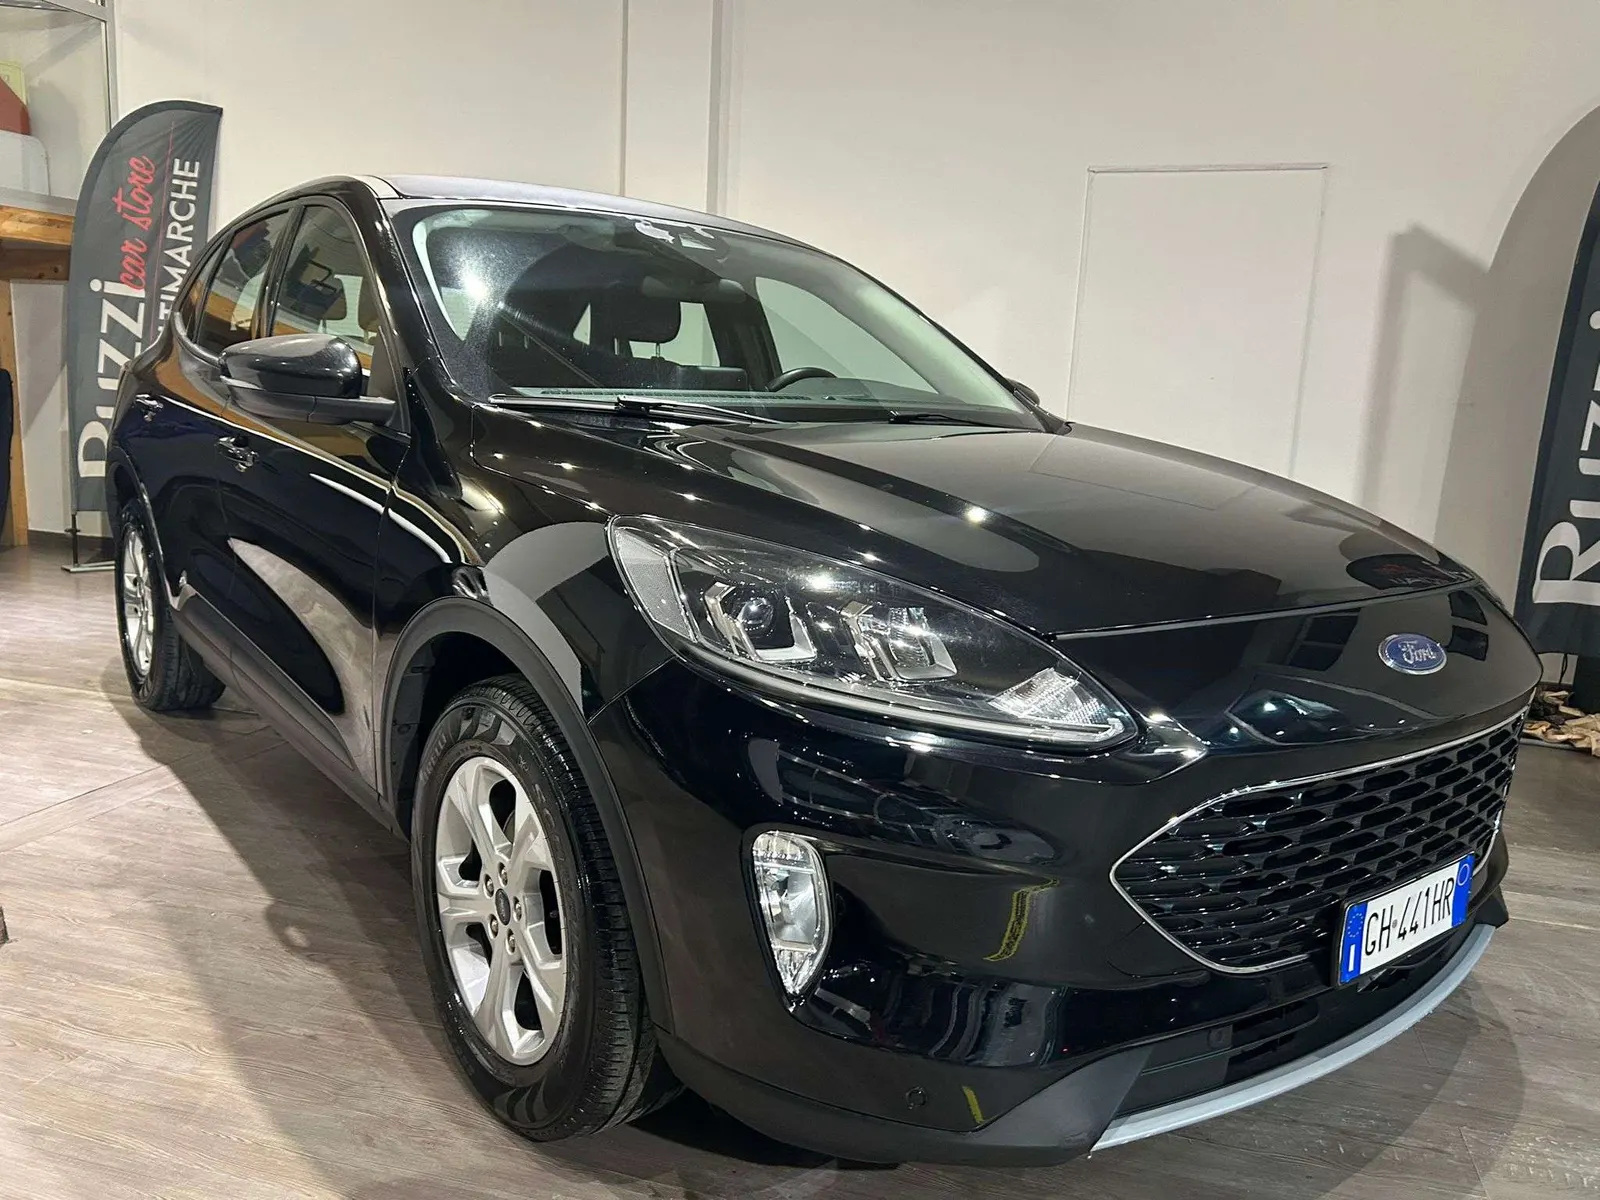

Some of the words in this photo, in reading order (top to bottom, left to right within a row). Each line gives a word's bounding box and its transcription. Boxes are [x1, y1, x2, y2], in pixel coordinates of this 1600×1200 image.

[111, 154, 156, 231] store
[119, 236, 148, 290] car
[1398, 640, 1437, 664] Ford
